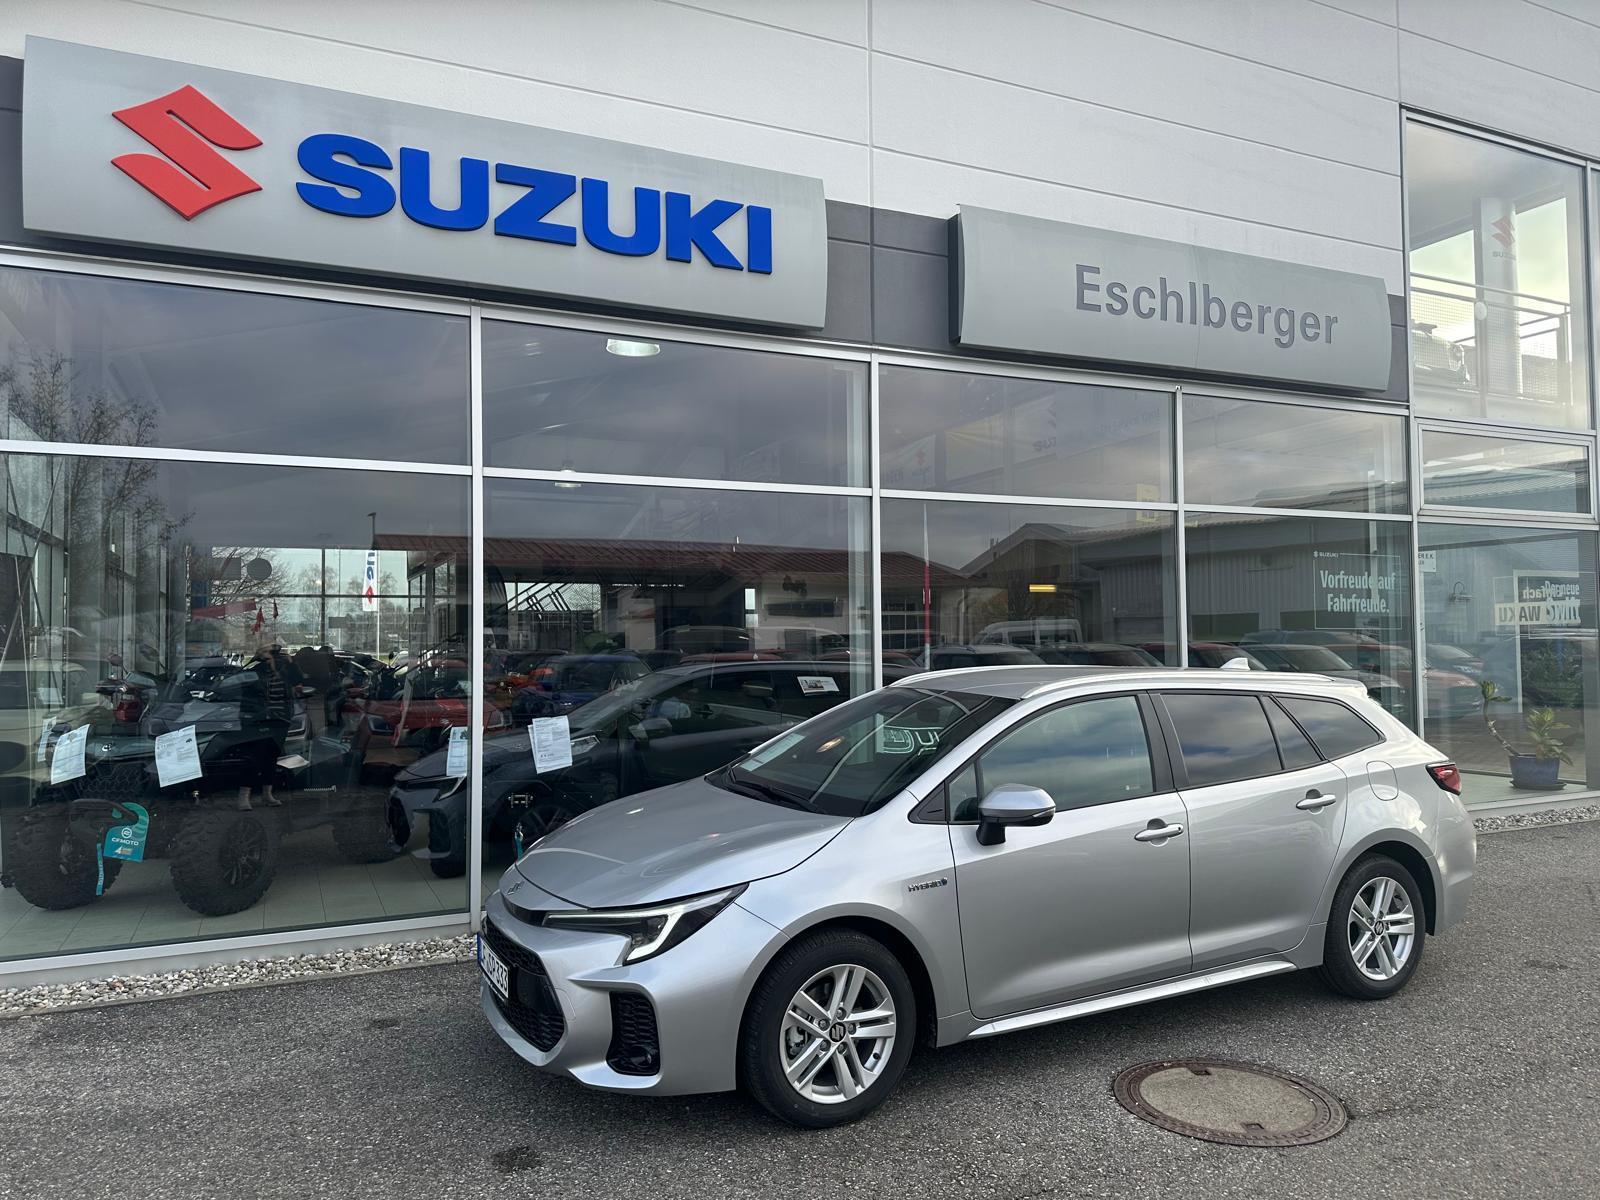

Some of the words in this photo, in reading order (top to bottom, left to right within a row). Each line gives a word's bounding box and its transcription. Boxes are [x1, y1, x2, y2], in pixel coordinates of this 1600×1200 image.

[295, 133, 773, 275] SUZUKI
[1075, 263, 1339, 349] Eschlberger
[1320, 570, 1376, 589] Vorfreude
[1378, 572, 1396, 590] auf
[1327, 593, 1390, 613] Fahrfreude.
[111, 837, 139, 846] CFMOTO
[496, 959, 508, 993] 333
